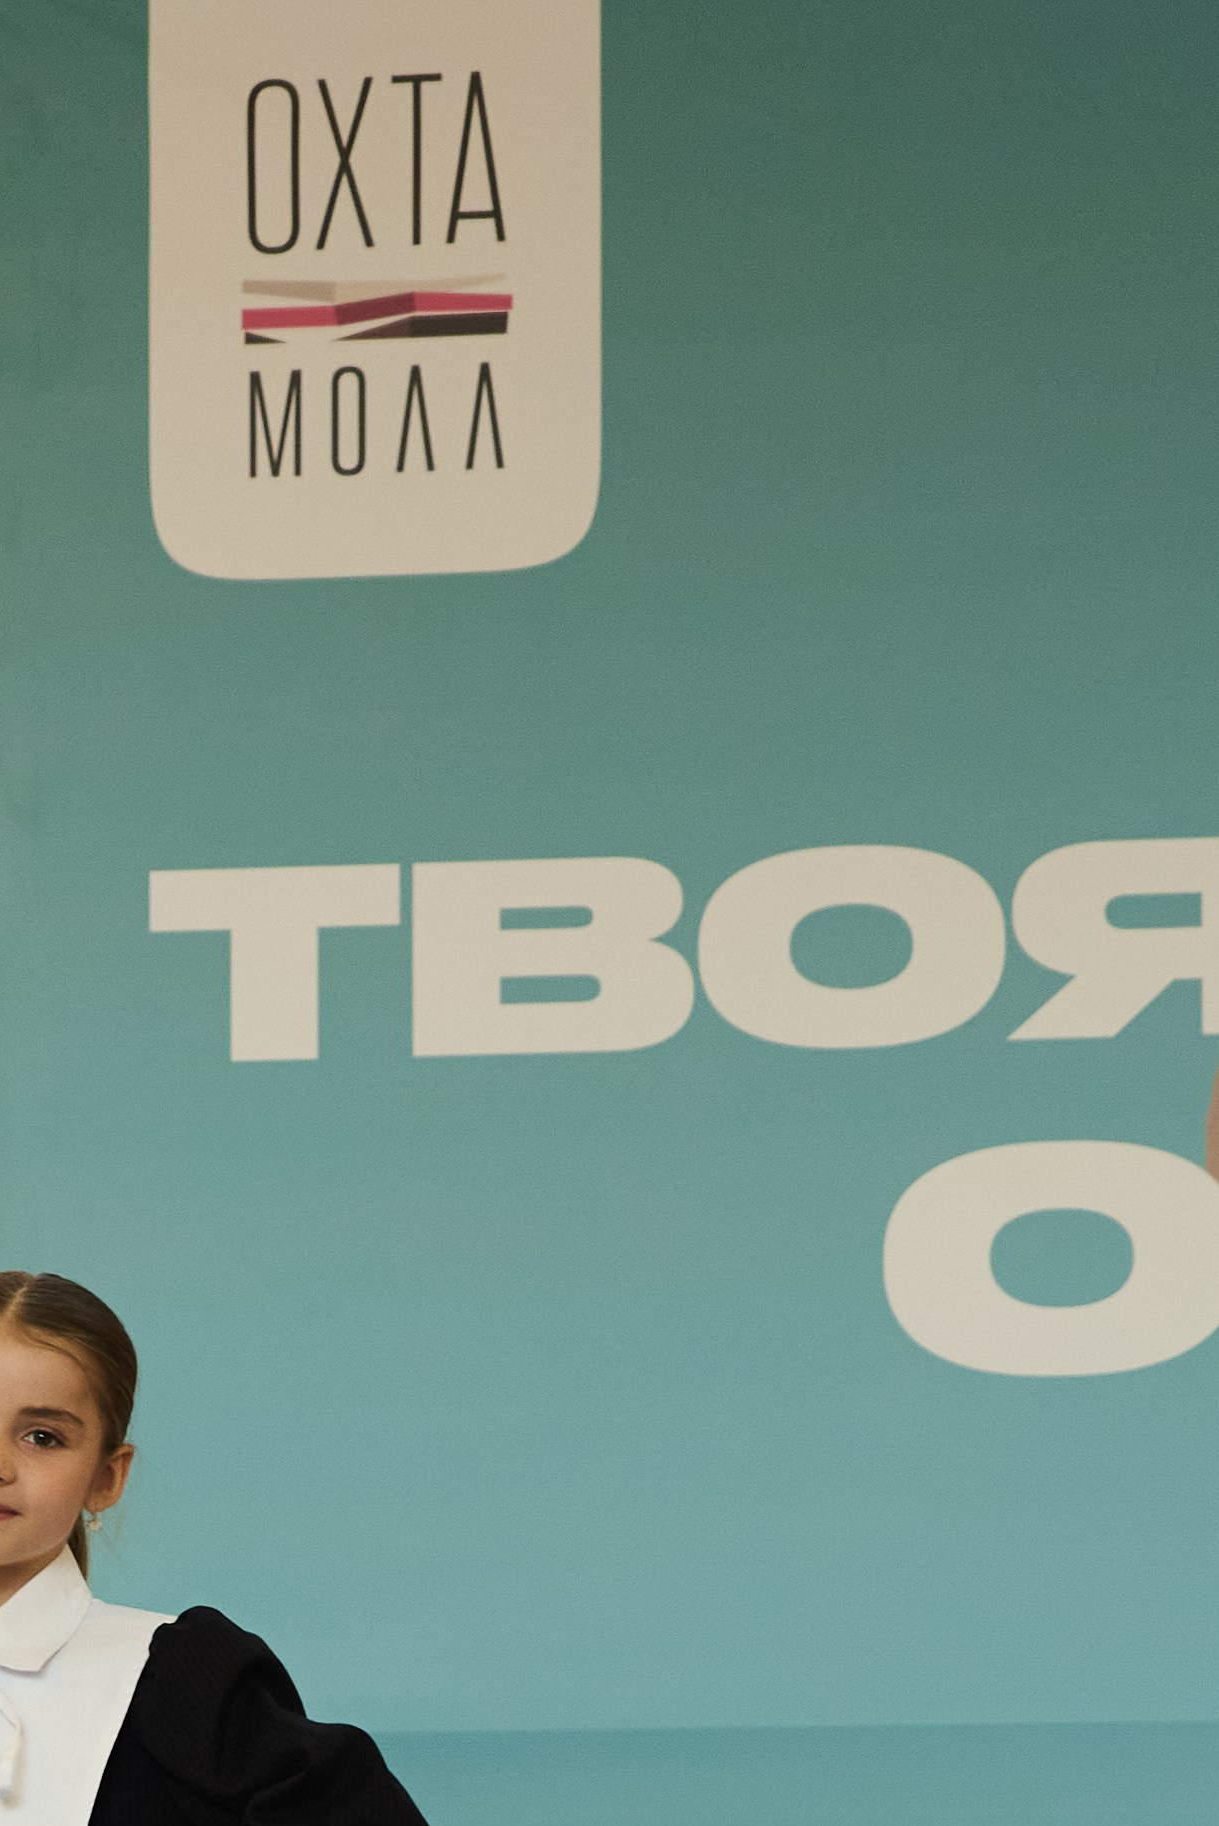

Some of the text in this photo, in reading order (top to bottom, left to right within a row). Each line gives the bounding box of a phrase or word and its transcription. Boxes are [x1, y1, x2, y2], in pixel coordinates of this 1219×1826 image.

[245, 70, 506, 255] ОХТА
[248, 361, 505, 478] МОЛЛ
[149, 836, 1219, 1062] ТВОЯ
